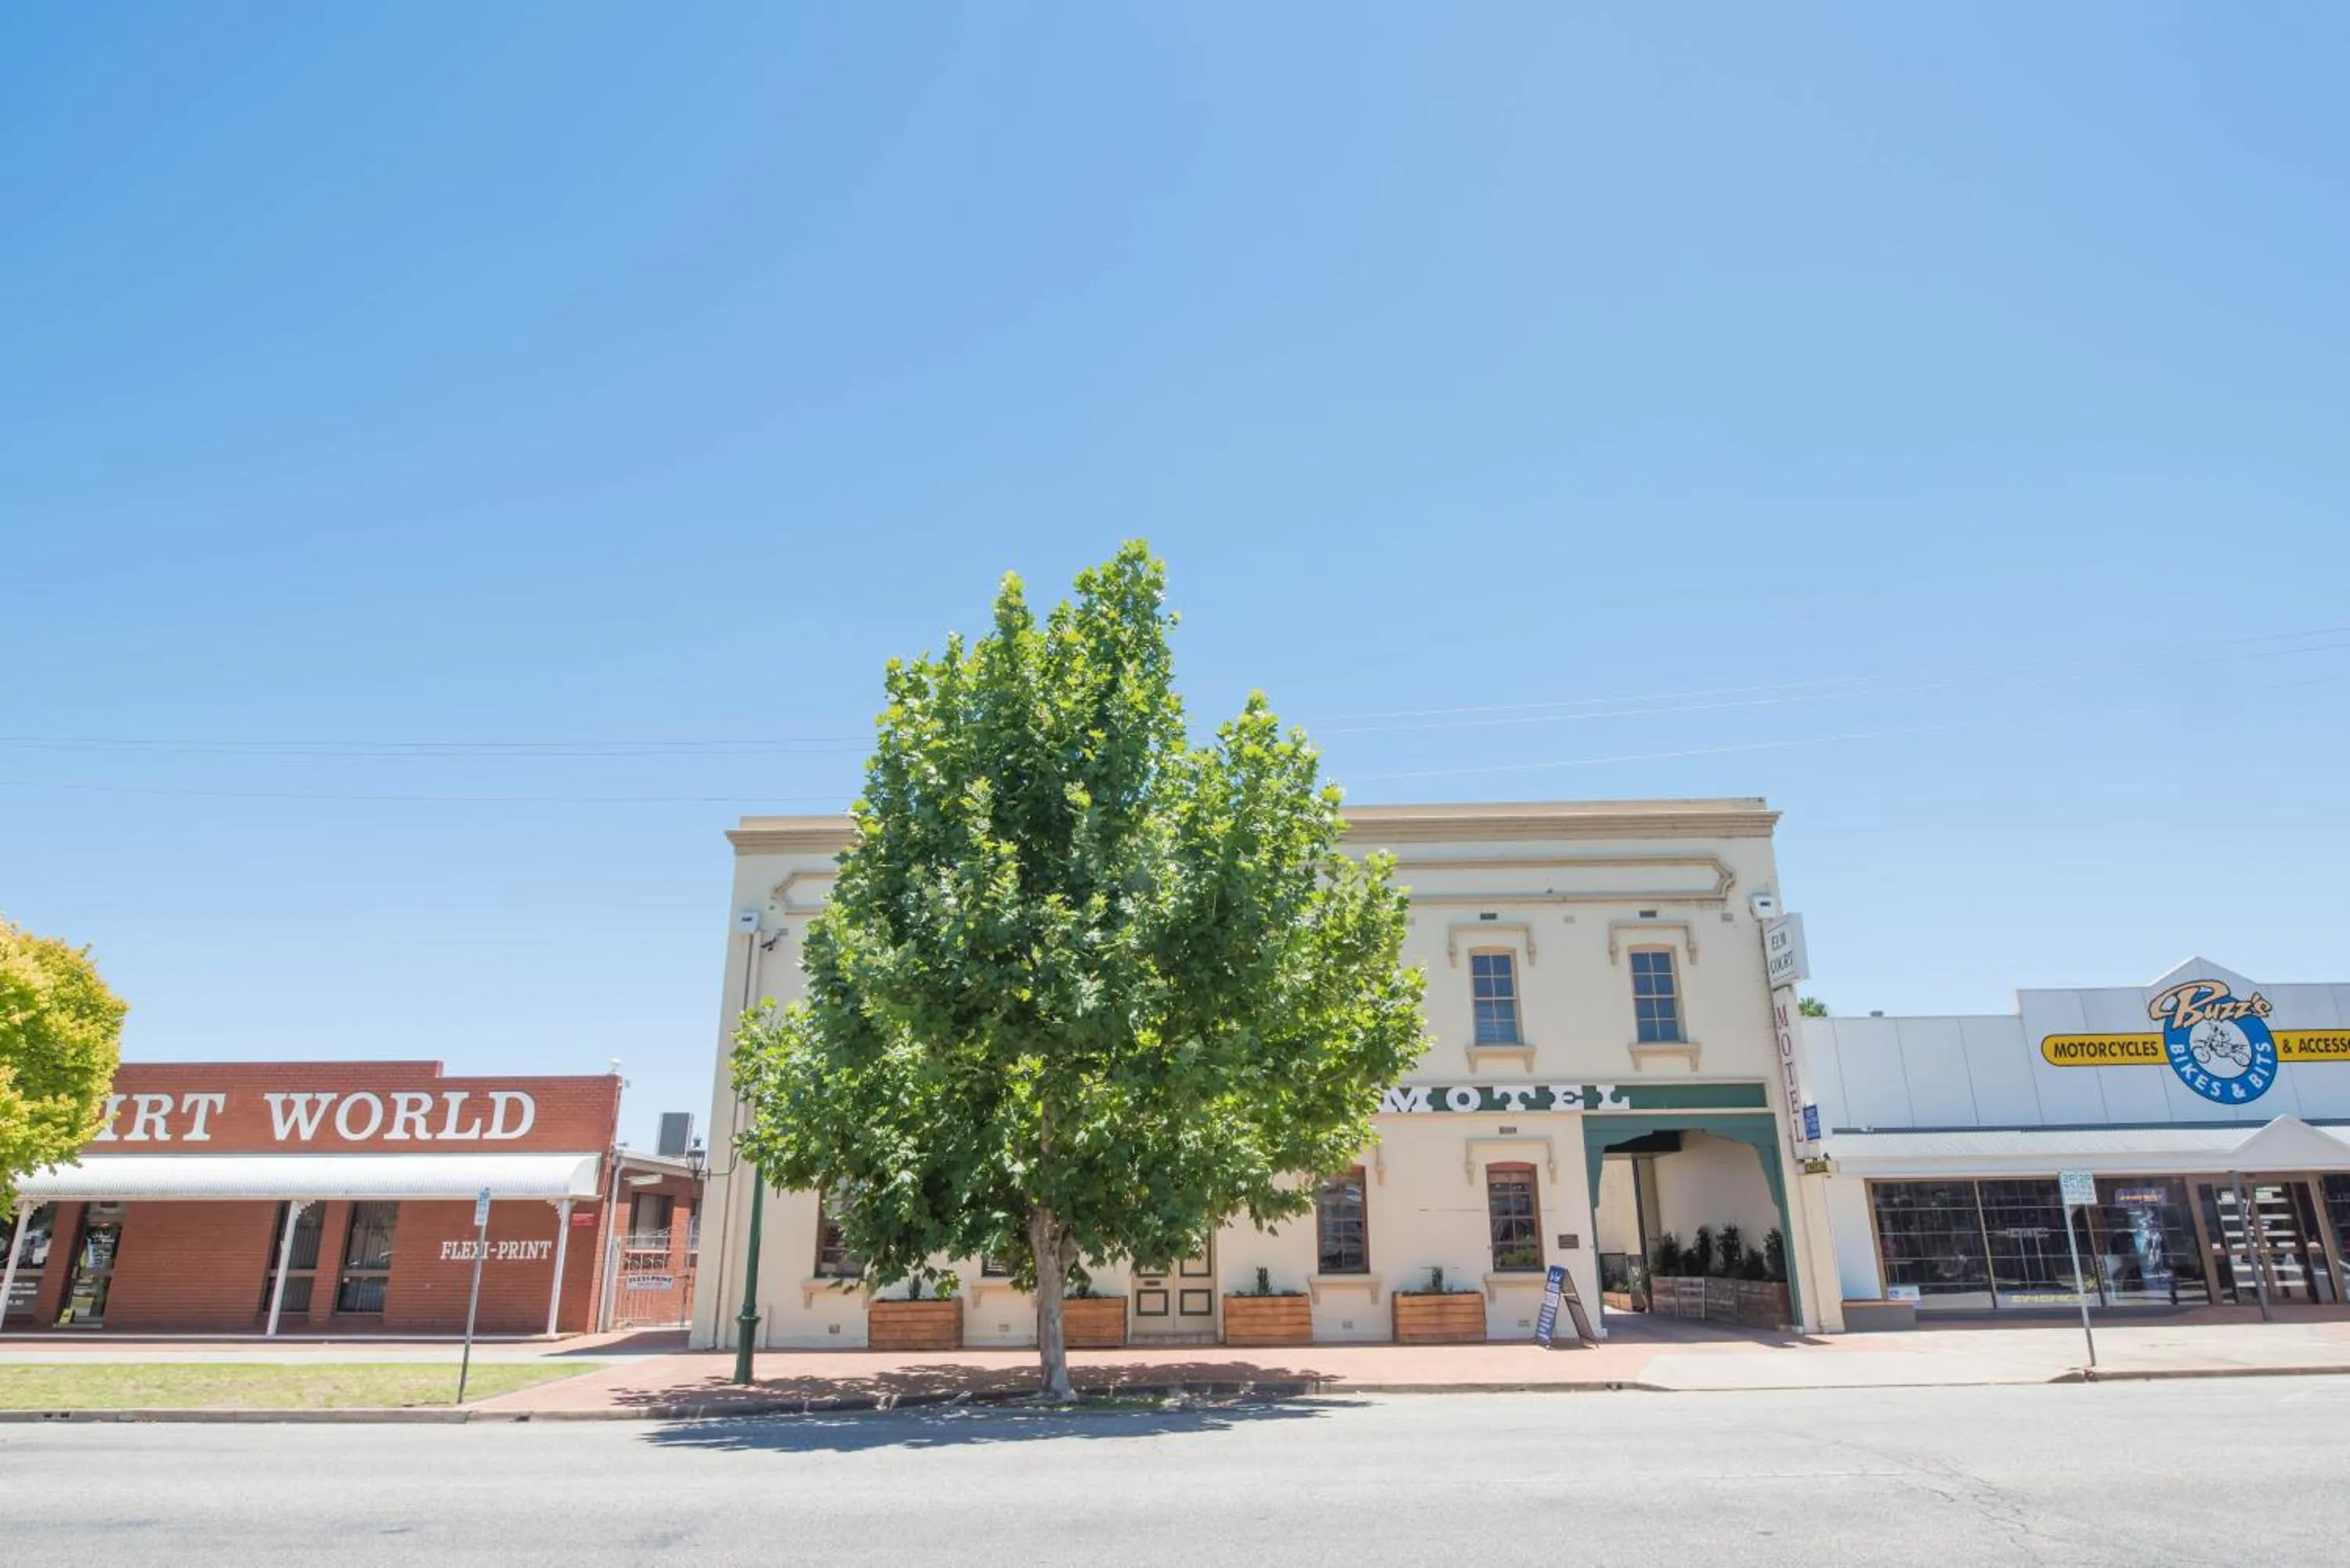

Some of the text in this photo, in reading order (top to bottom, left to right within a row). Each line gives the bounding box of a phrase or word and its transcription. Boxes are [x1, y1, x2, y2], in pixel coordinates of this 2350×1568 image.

[2054, 1036, 2350, 1058] MOTORCYCLES & ACCESS
[2169, 1040, 2273, 1099] BIKES & BITS
[1776, 1004, 1804, 1143] MOTEL
[92, 1092, 536, 1141] IRT WORLD
[1377, 1085, 1630, 1113] MOTEL
